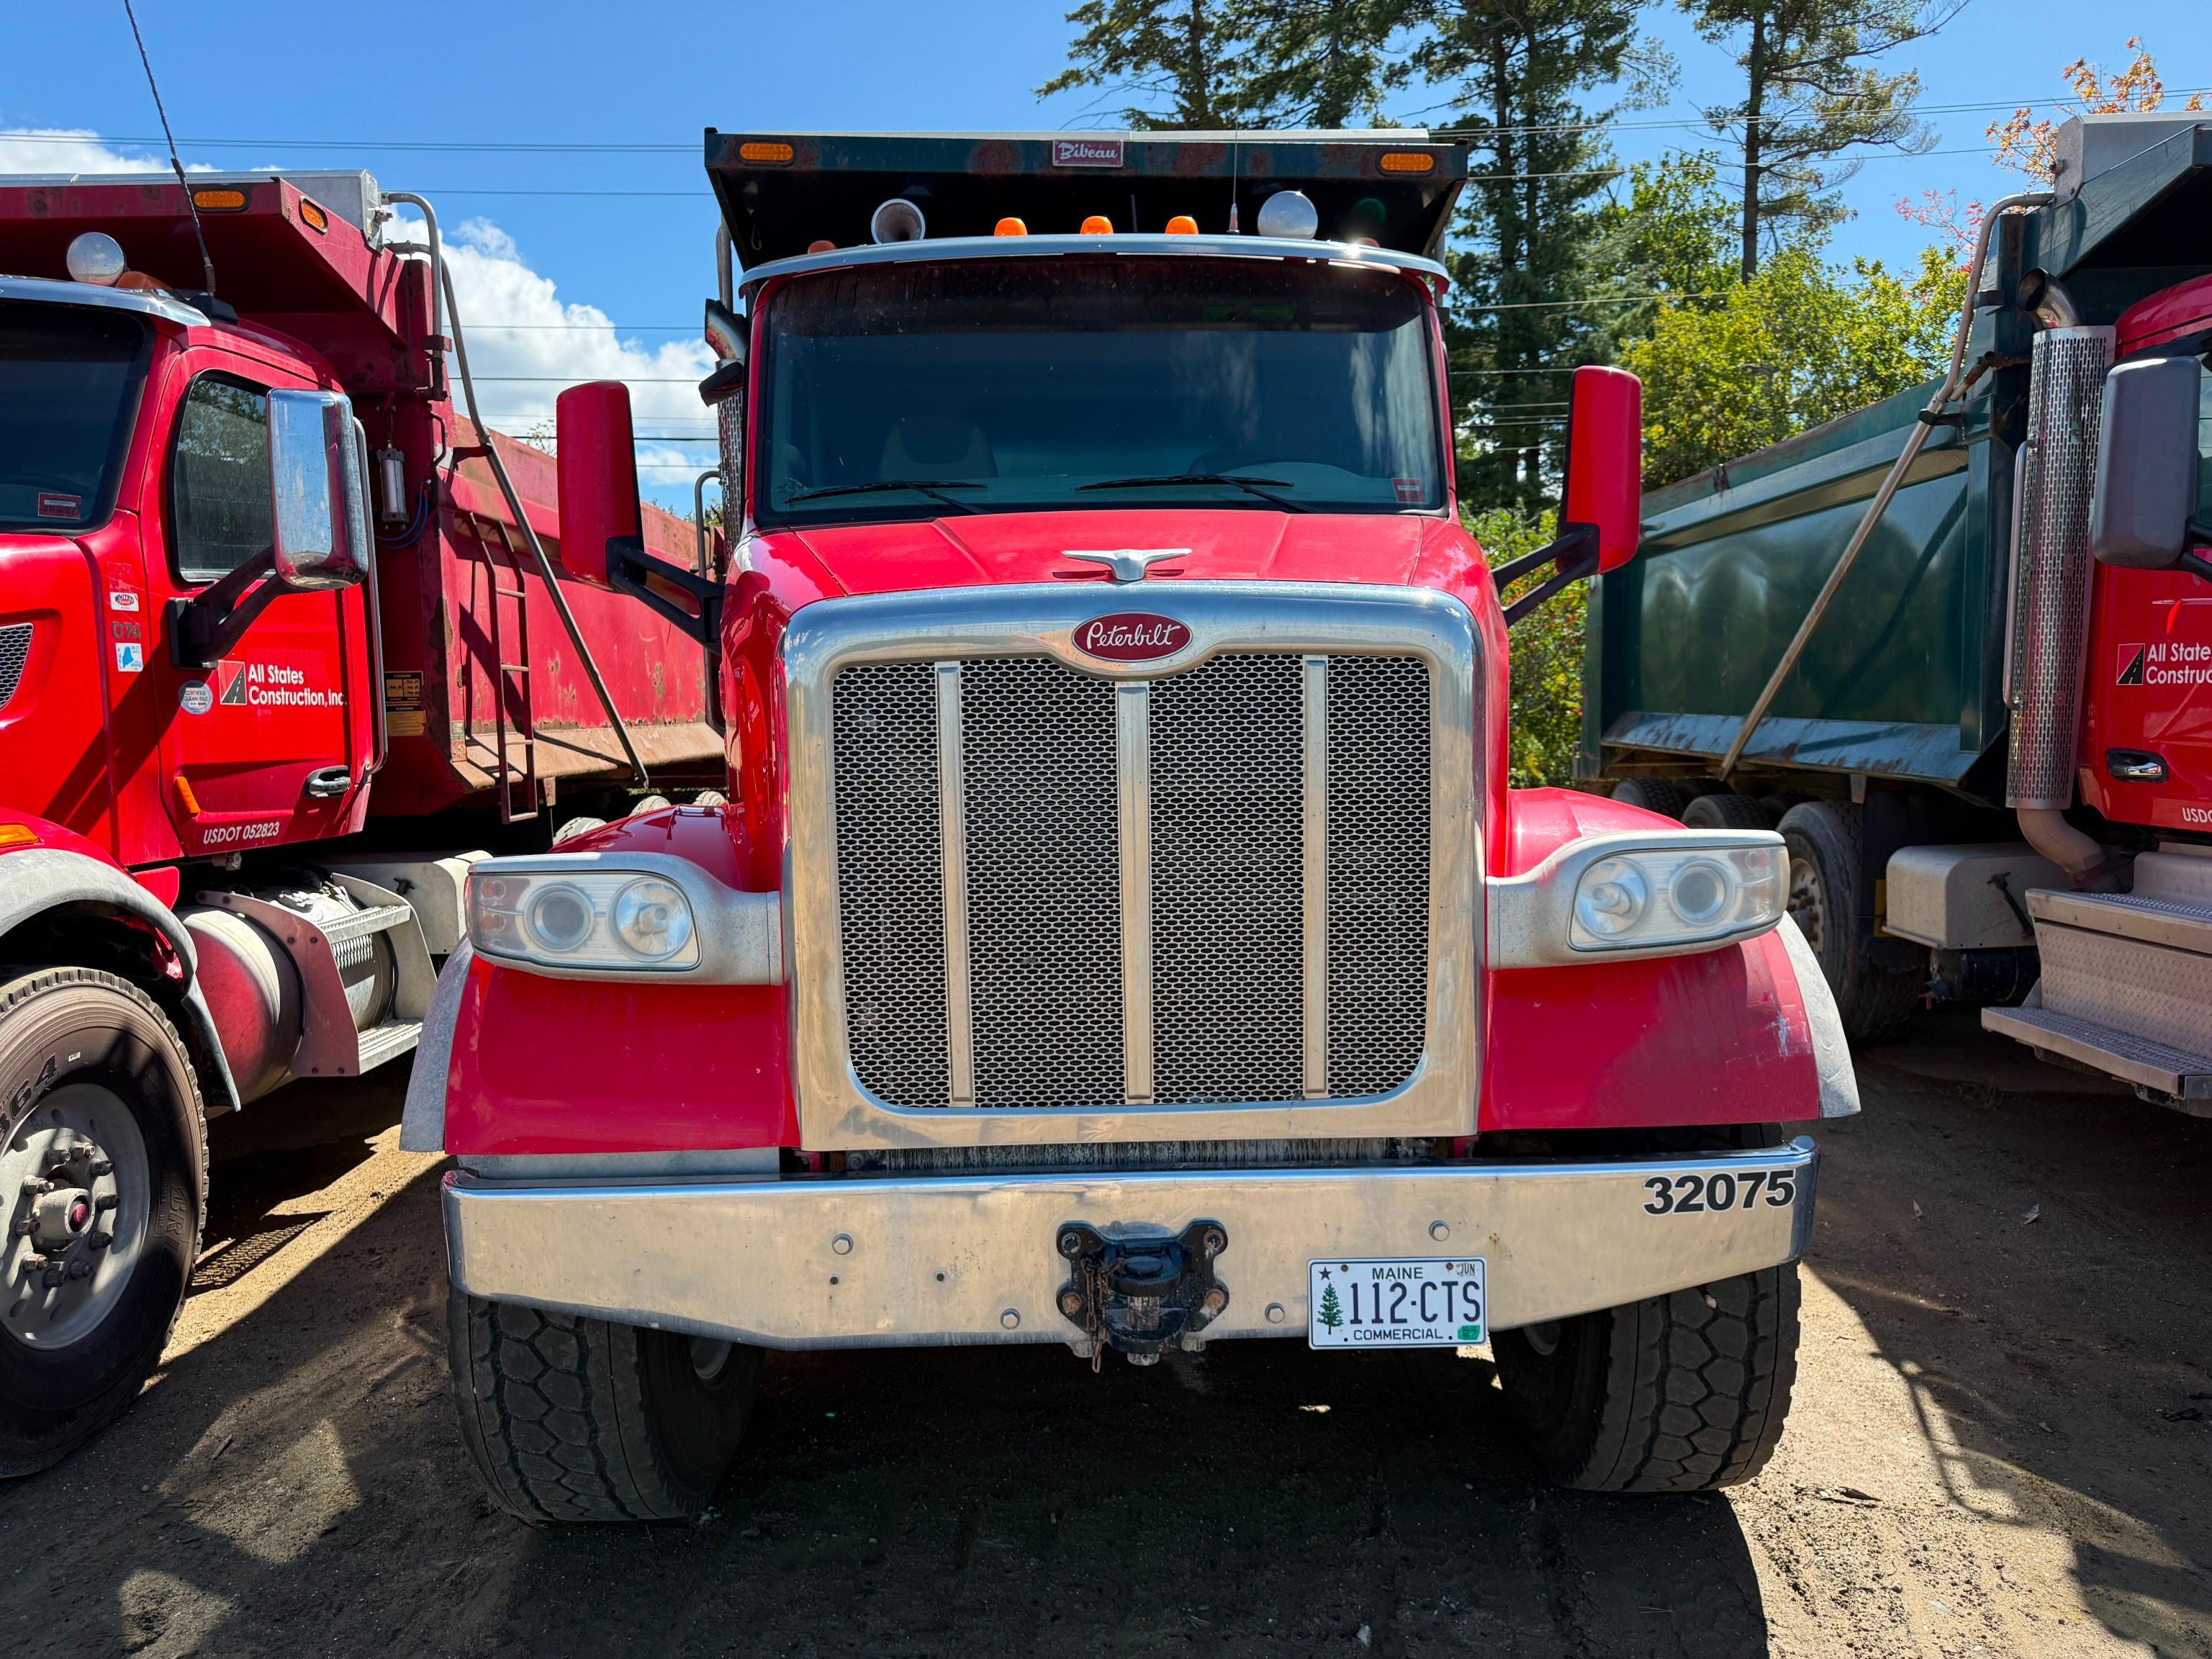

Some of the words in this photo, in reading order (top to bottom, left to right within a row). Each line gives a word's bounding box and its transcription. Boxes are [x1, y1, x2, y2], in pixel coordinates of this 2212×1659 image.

[1058, 142, 1118, 160] Bibeau
[112, 621, 142, 640] 074
[1086, 621, 1181, 650] Peterbilt
[2146, 643, 2166, 662] All
[2170, 642, 2212, 662] State
[248, 664, 265, 683] All
[268, 664, 304, 684] States
[203, 826, 242, 844] USDOT
[243, 822, 280, 840] 052823
[1643, 1169, 1795, 1215] 32075
[1371, 1267, 1424, 1280] MAINE
[1458, 1262, 1476, 1275] JUN
[1353, 1328, 1444, 1341] COMMERCIAL
